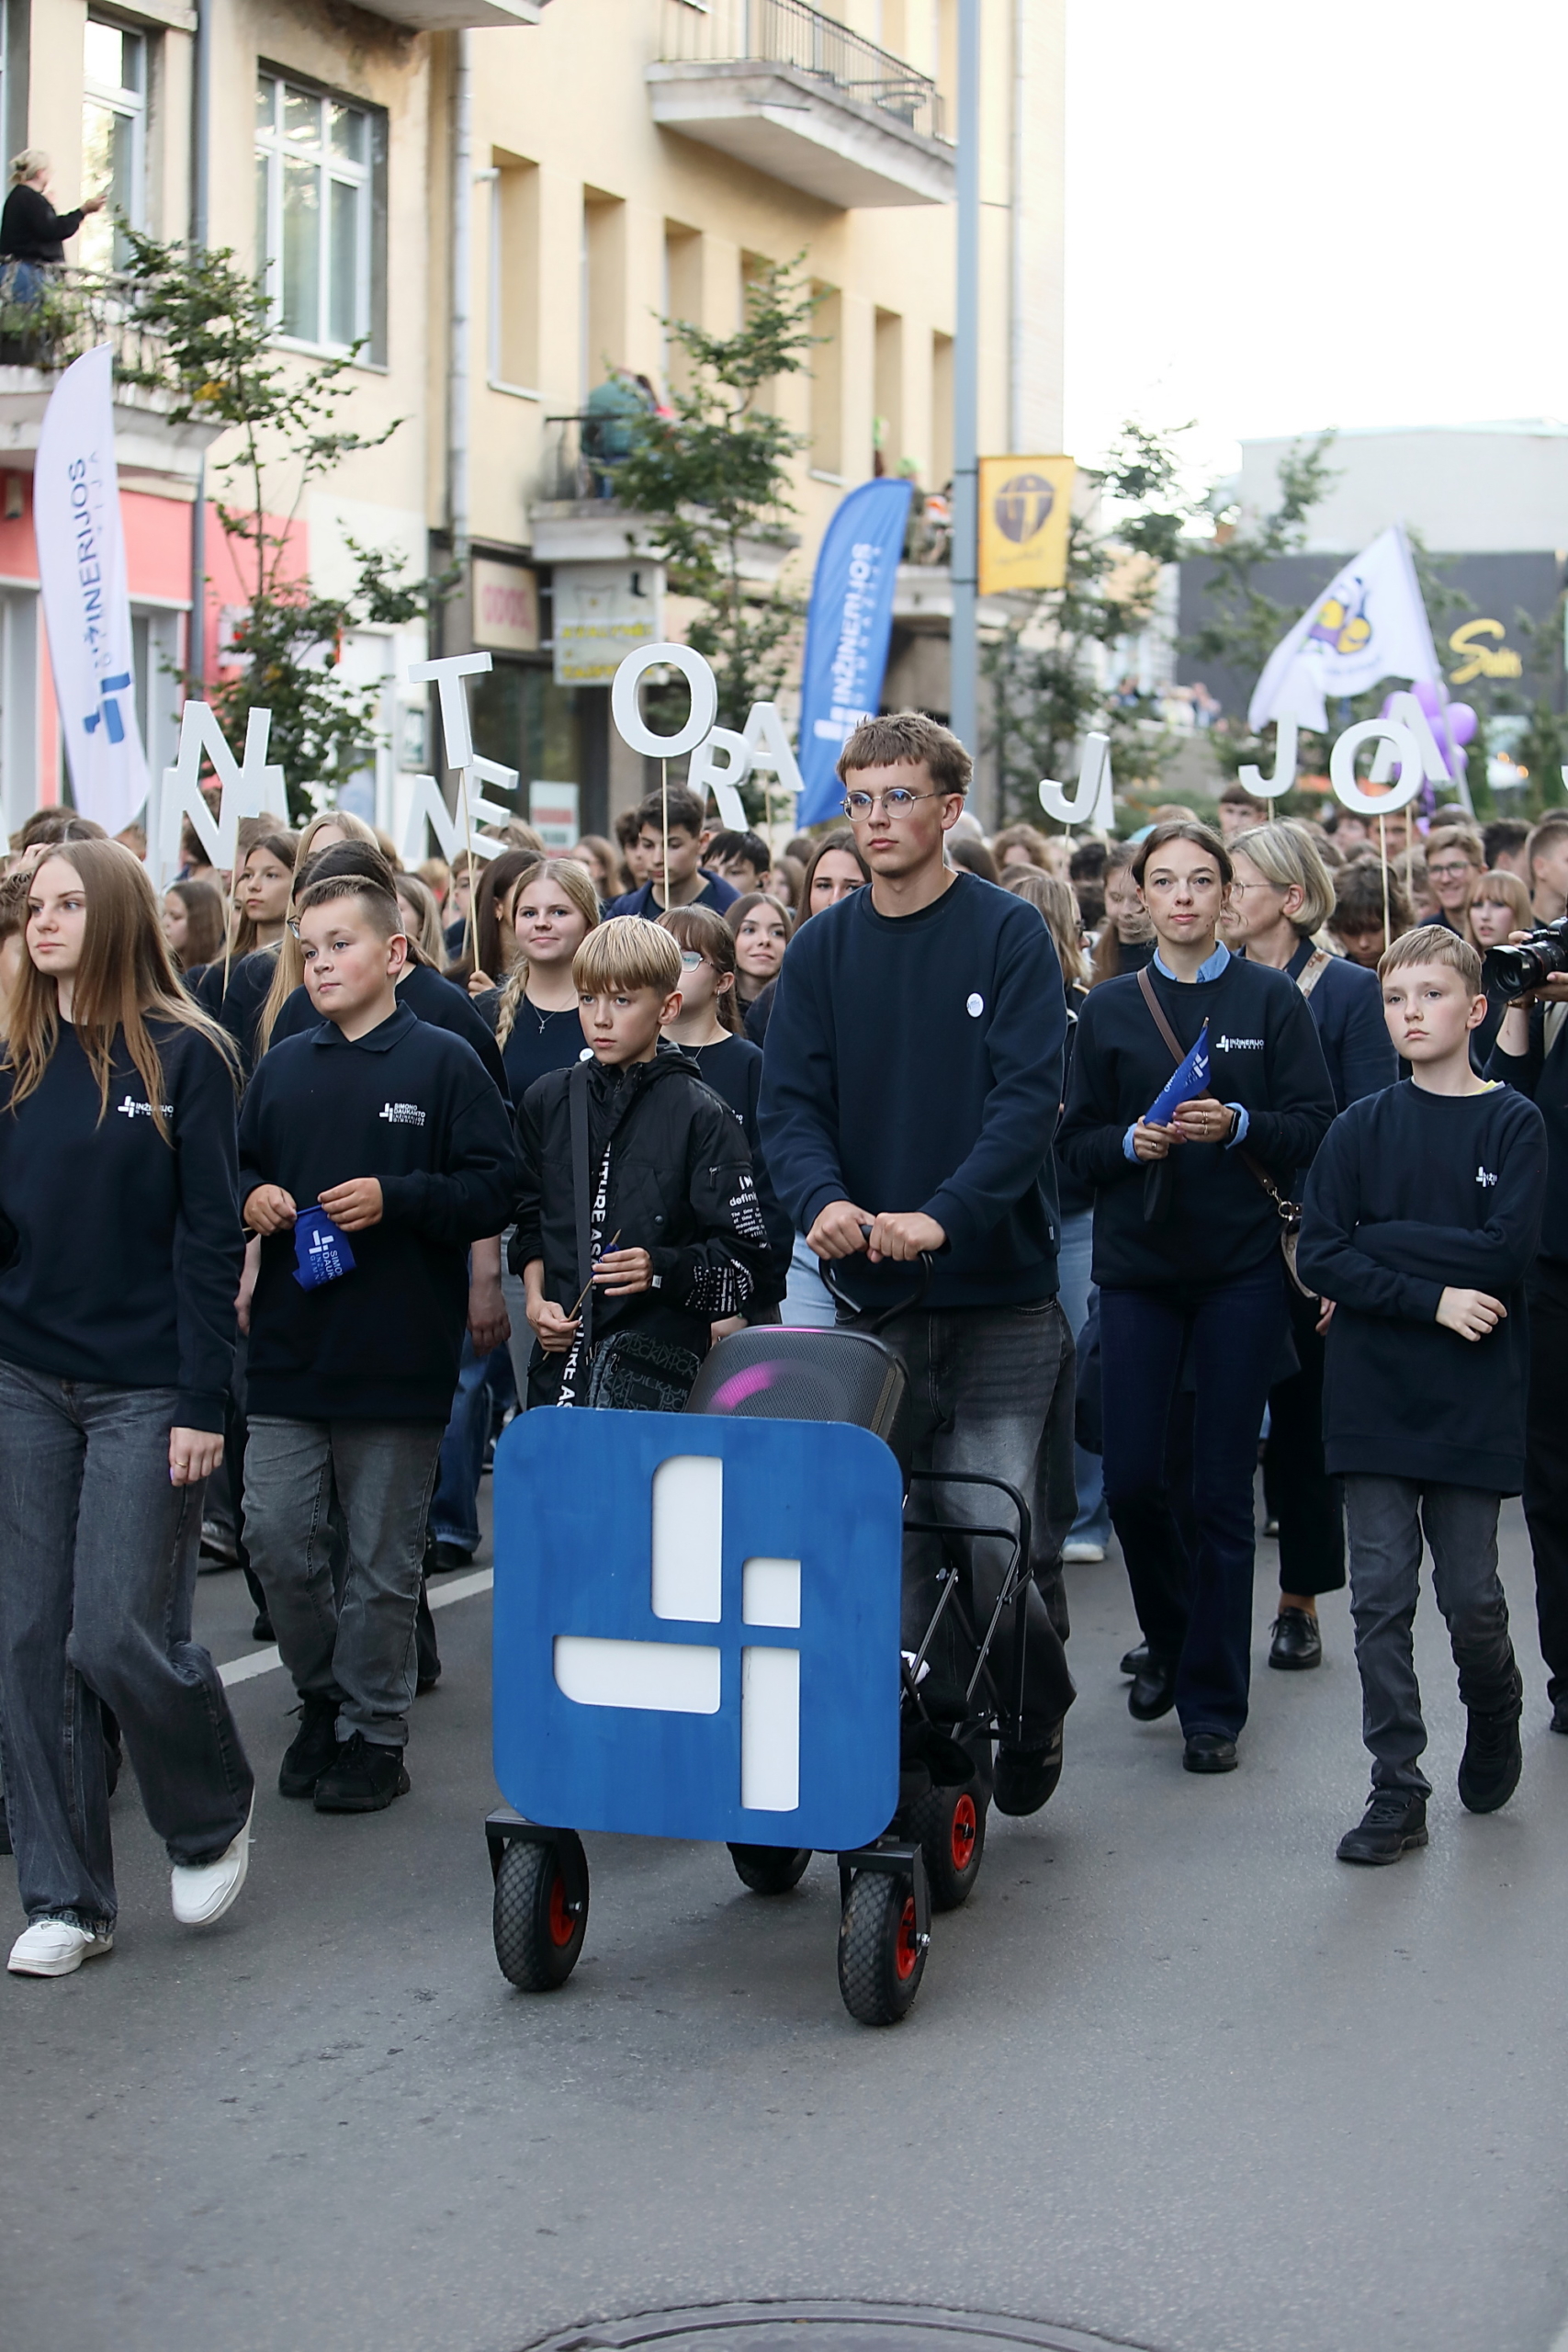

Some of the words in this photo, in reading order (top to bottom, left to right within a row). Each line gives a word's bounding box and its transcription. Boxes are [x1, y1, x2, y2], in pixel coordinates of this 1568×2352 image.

[408, 651, 493, 770] T
[612, 643, 718, 758] O
[742, 701, 806, 792] A
[177, 700, 272, 819] N
[687, 725, 751, 833] R
[1039, 732, 1111, 824] J
[1239, 712, 1298, 797] J
[1330, 718, 1423, 815] O
[322, 1251, 334, 1280] DAUK
[330, 1250, 344, 1276] SIMO
